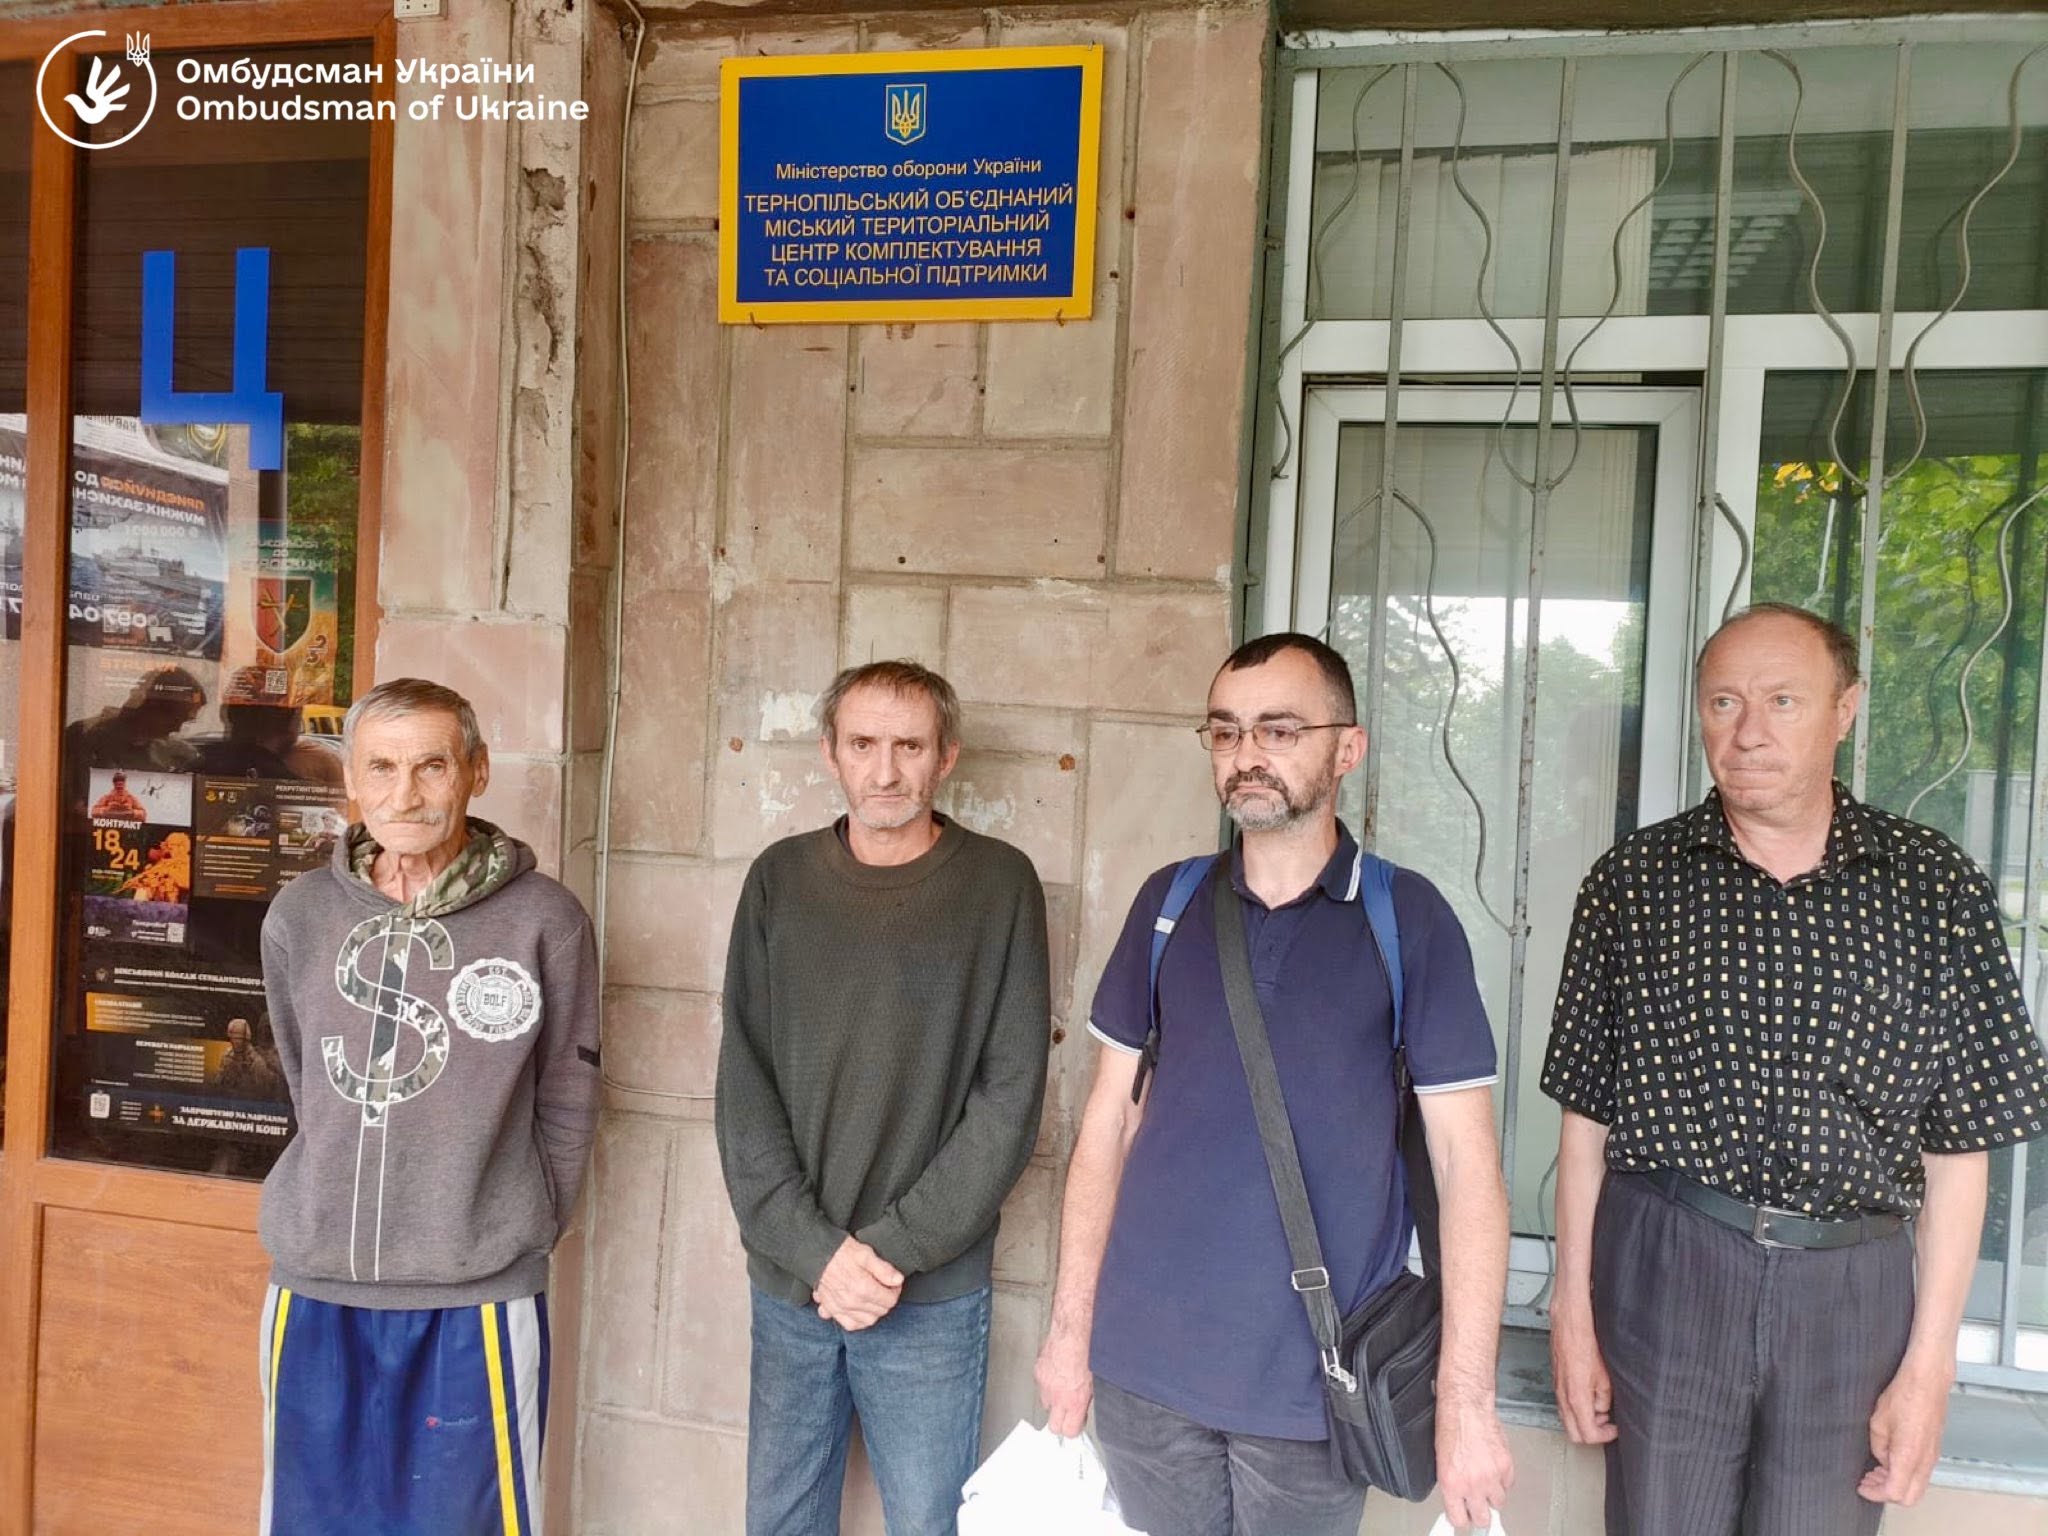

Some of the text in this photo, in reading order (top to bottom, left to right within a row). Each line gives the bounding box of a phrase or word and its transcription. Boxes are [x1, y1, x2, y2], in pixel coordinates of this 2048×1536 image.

[776, 157, 1042, 182] Міністерство оборони України
[744, 183, 1073, 213] ТЕРНОПІЛЬСЬКИЙ ОБ'ЄДНАНИЙ
[765, 210, 1049, 237] МІСЬКИЙ ТЕРИТОРІАЛЬНИЙ
[771, 238, 1041, 265] ЦЕНТР КОМПЛЕКТУВАННЯ
[764, 262, 1047, 289] ТА СОЦІАЛЬНОЇ ПІДТРИМКИ
[141, 247, 283, 470] Ц
[92, 818, 142, 830] КОНТРАКТ
[92, 829, 121, 851] 18
[110, 848, 140, 870] 24
[186, 1117, 254, 1133] ДЕРЖАВНИЙ
[255, 1124, 289, 1136] КОШТ
